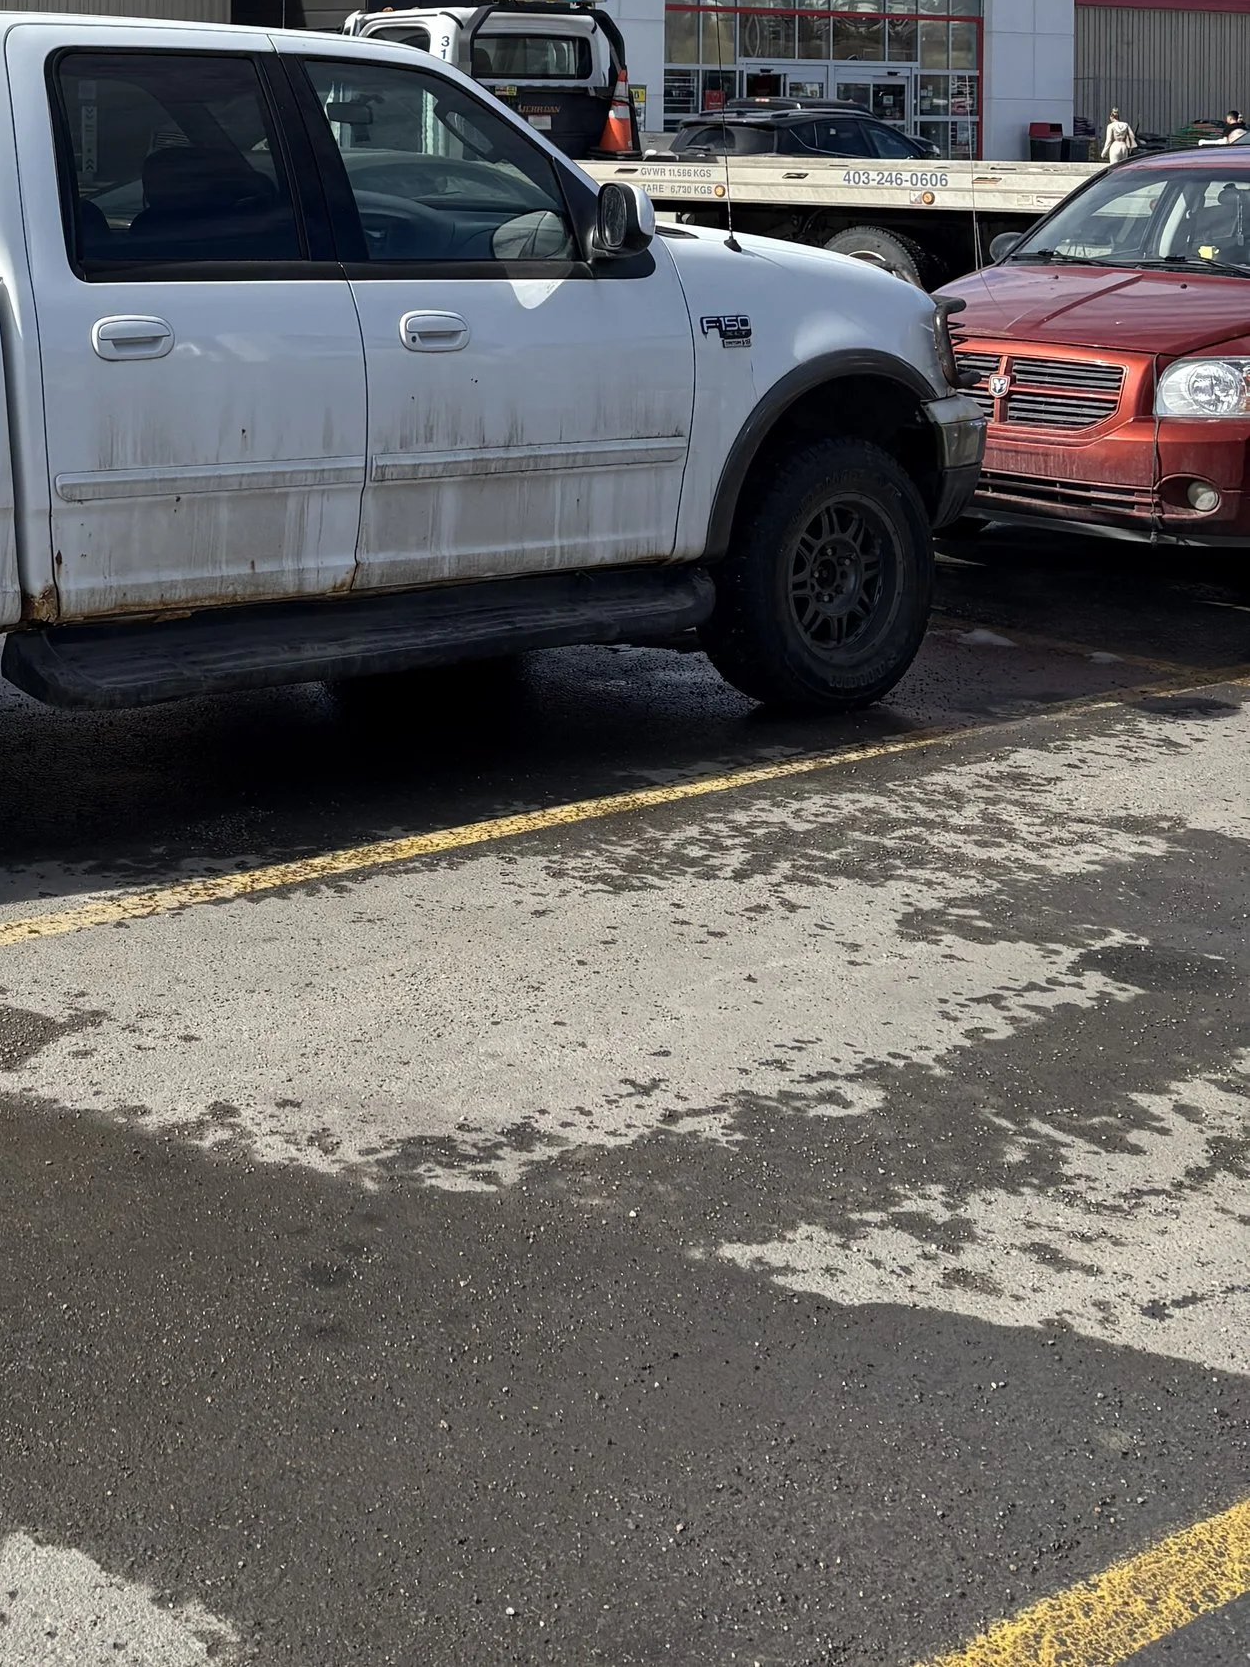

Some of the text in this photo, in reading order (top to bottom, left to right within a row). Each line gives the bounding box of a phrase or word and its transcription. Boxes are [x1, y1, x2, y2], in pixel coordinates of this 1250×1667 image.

[640, 167, 666, 177] GVWR
[693, 169, 712, 178] KGS
[843, 170, 949, 187] 403-246-0606
[642, 184, 665, 193] TARE
[694, 186, 713, 195] KGS
